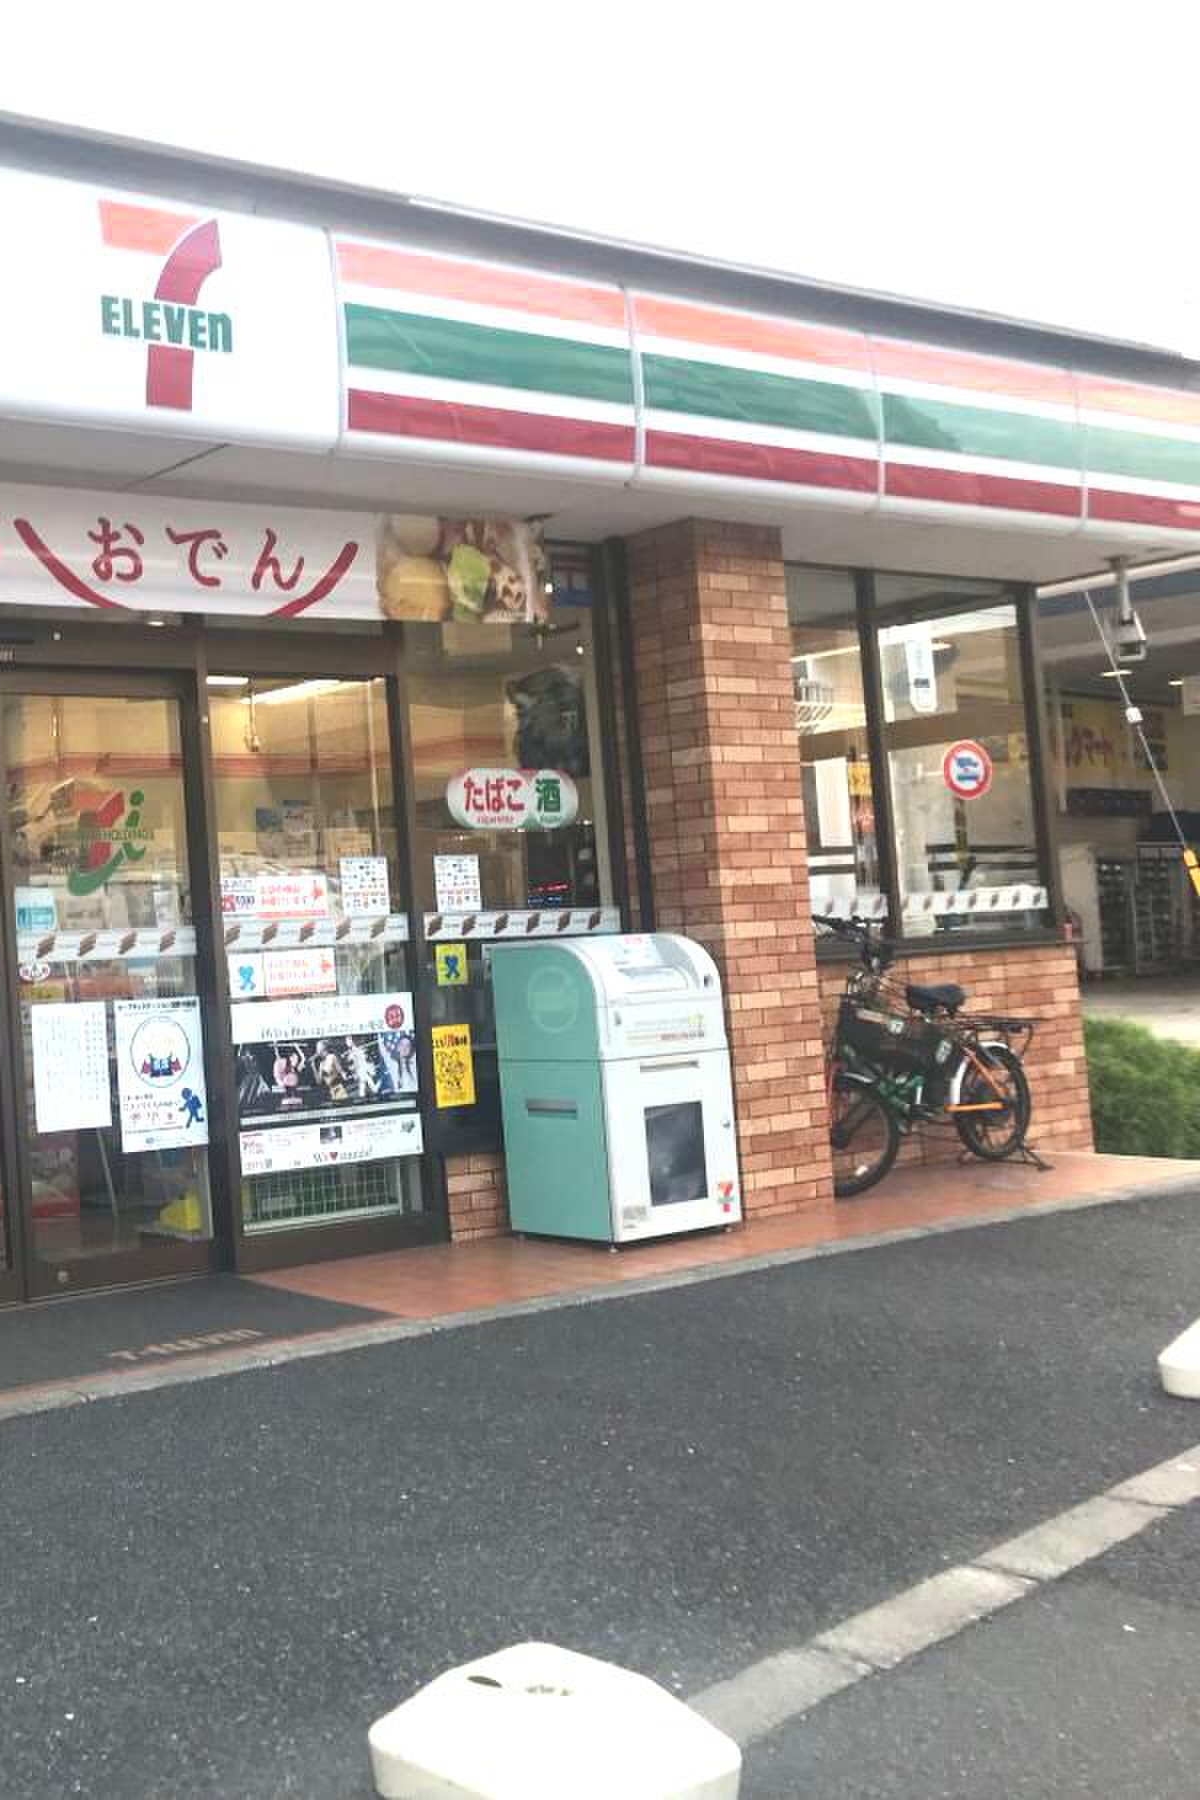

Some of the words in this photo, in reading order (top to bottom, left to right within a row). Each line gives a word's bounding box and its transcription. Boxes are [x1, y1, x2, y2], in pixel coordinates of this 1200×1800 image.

[86, 517, 305, 591] おでん
[463, 776, 525, 813] たばこ
[535, 777, 561, 813] 酒
